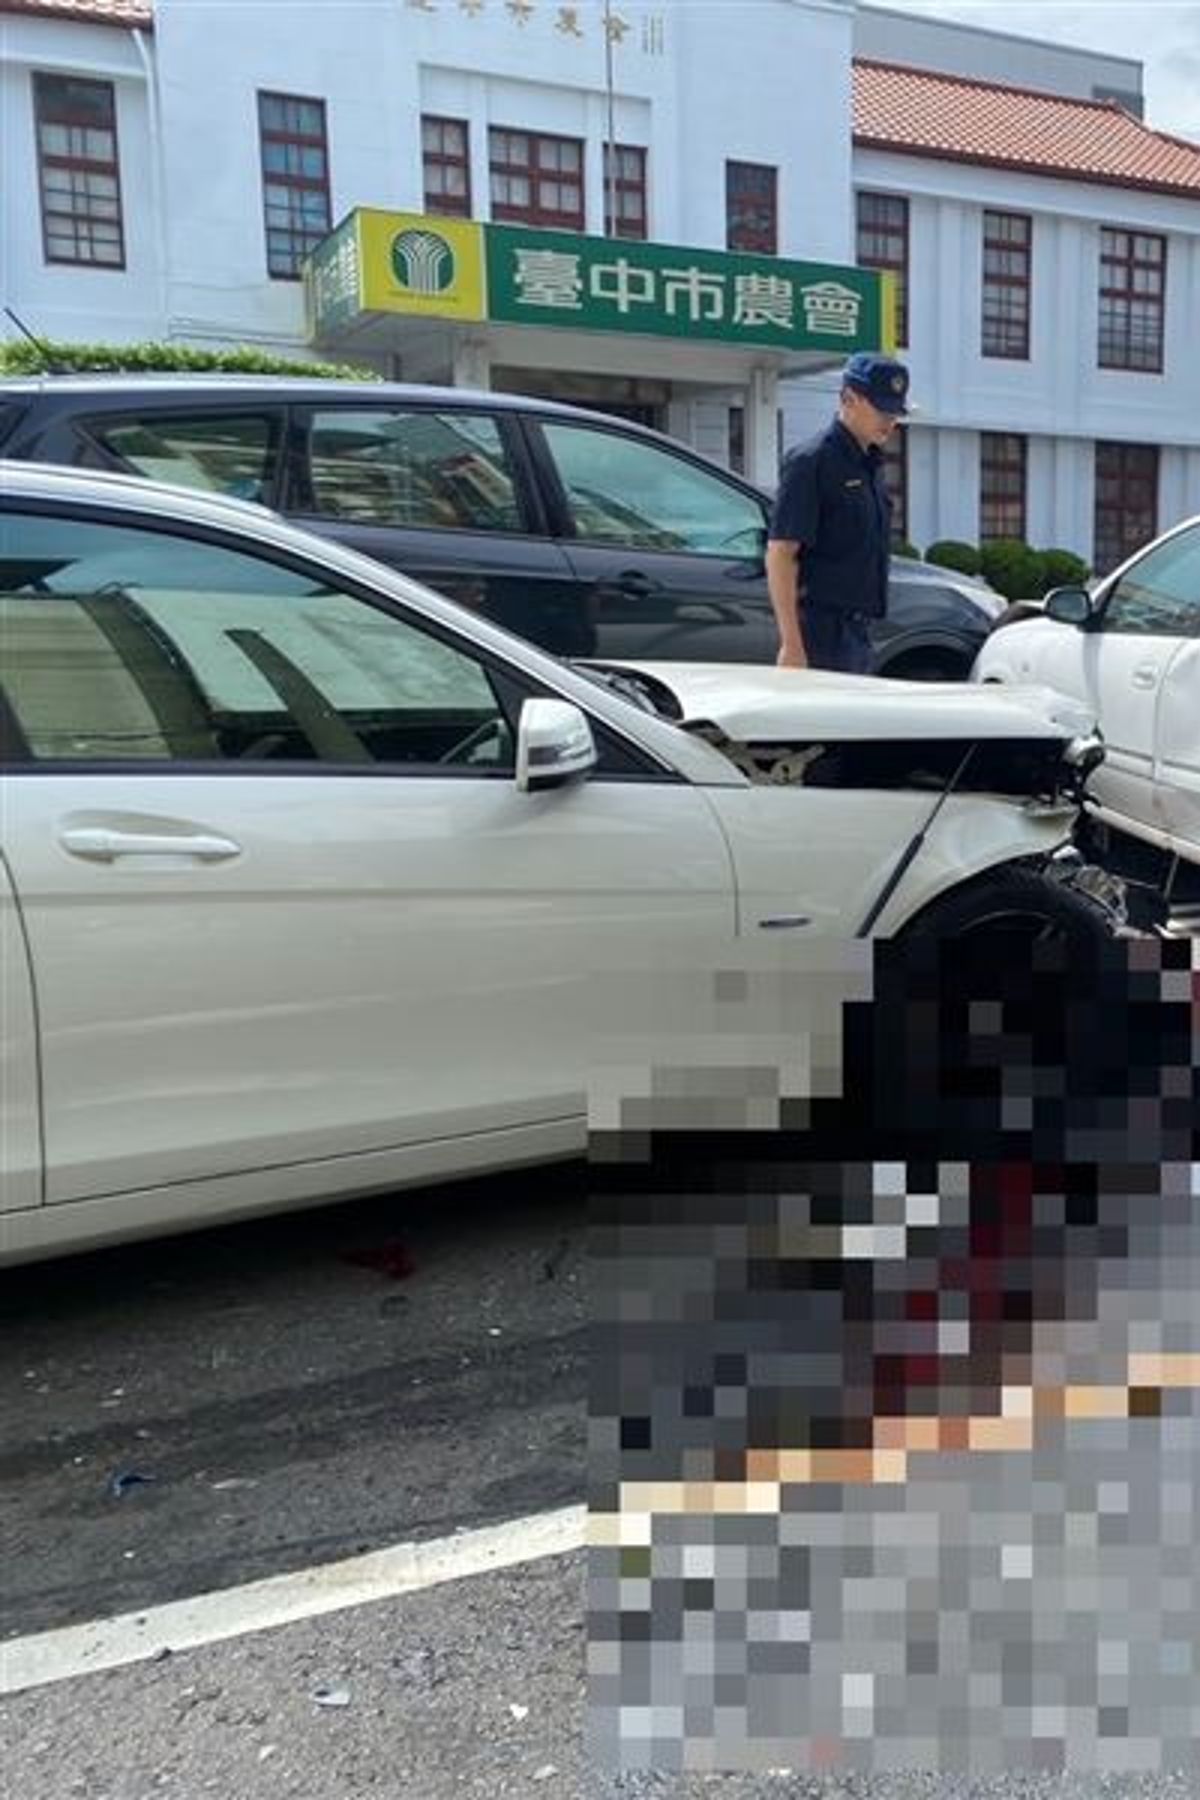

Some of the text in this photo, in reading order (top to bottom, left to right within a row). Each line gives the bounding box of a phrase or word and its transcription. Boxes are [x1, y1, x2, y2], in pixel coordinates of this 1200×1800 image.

[514, 248, 863, 337] 臺中市農會
